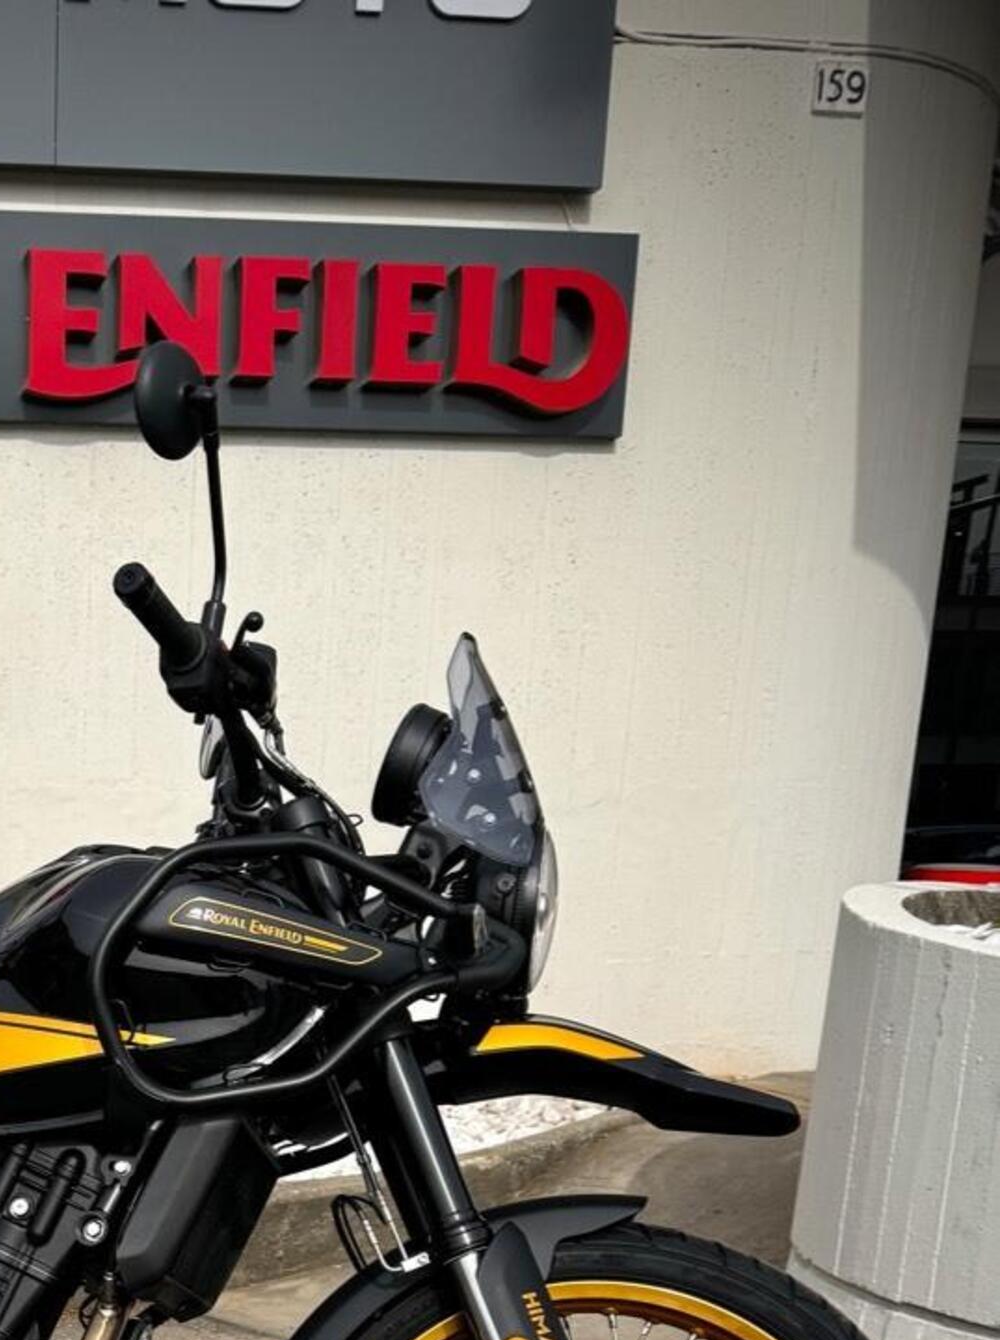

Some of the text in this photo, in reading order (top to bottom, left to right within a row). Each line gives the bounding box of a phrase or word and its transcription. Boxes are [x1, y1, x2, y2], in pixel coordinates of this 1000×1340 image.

[818, 69, 865, 104] 159
[22, 248, 630, 415] ENFIELD
[203, 907, 303, 944] ROYAL ENFIELD
